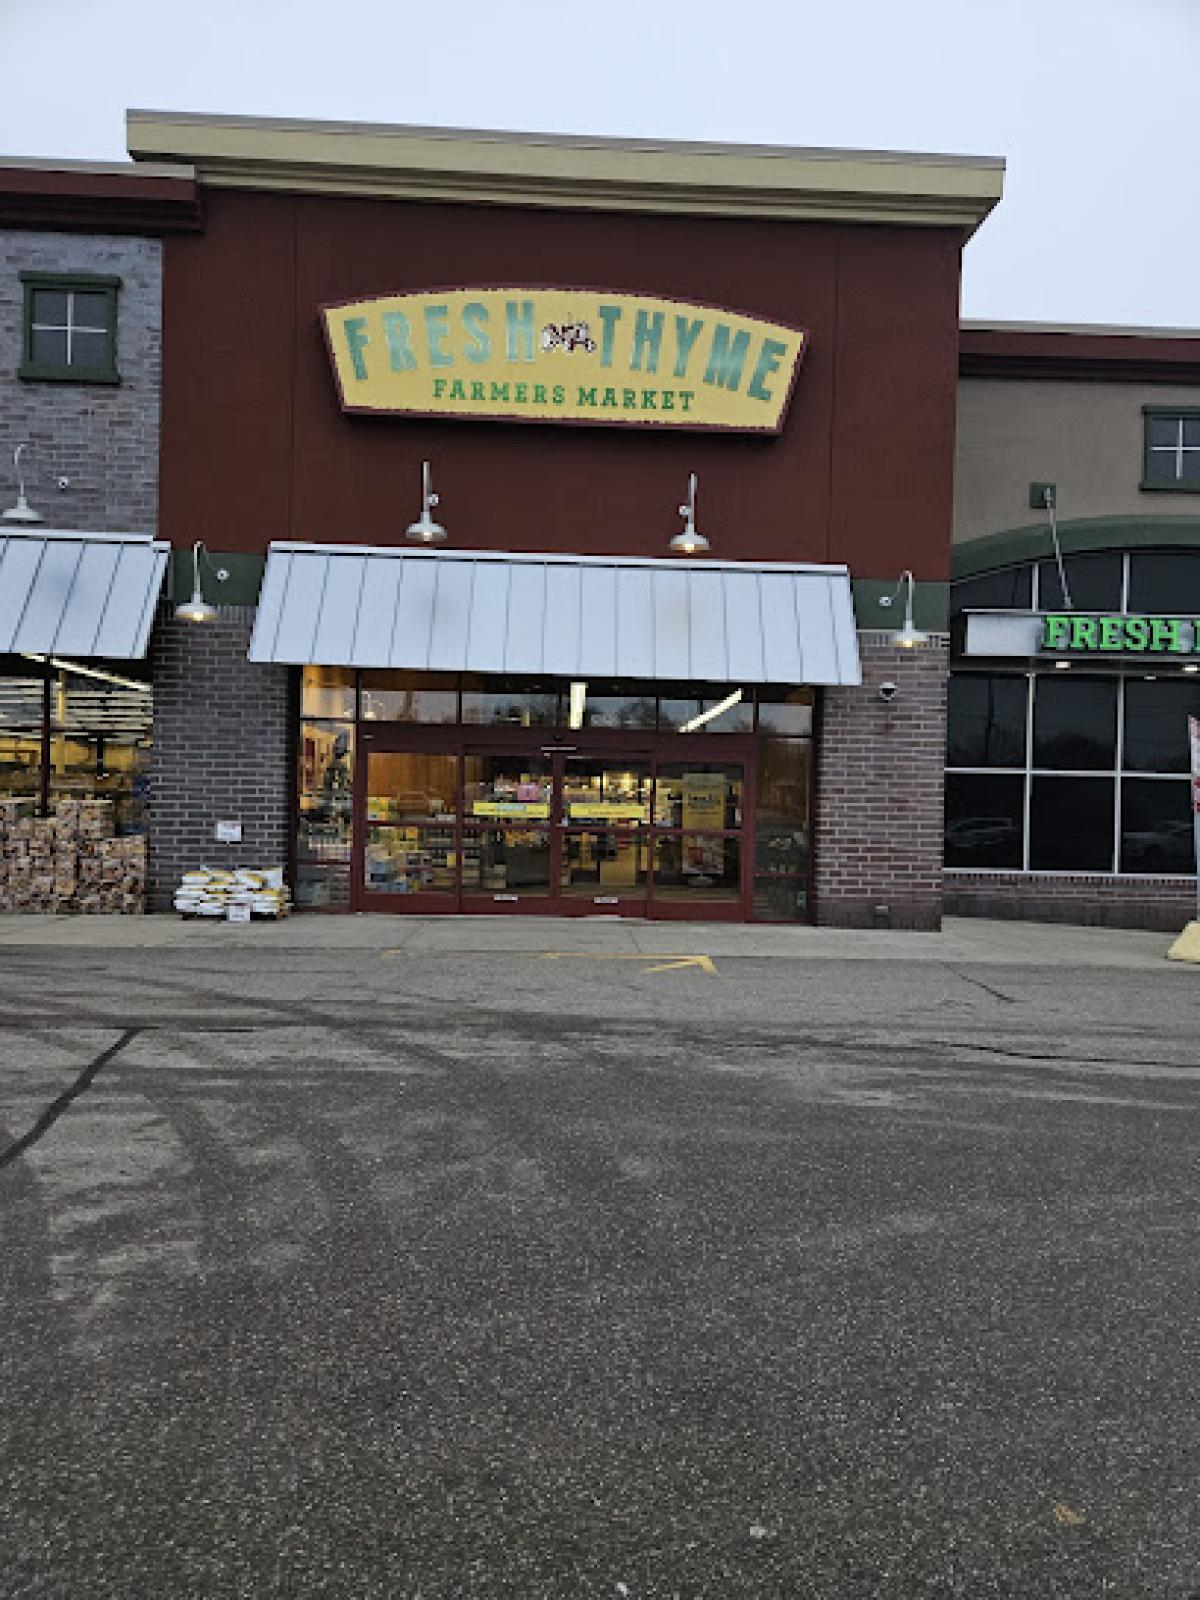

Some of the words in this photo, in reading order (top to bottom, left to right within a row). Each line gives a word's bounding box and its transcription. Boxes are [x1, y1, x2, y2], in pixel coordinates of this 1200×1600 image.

[344, 300, 536, 380] FRESH
[599, 305, 787, 401] THYME
[432, 379, 565, 404] FARMERS
[577, 386, 695, 412] MARKET
[1045, 617, 1180, 650] FRESH
